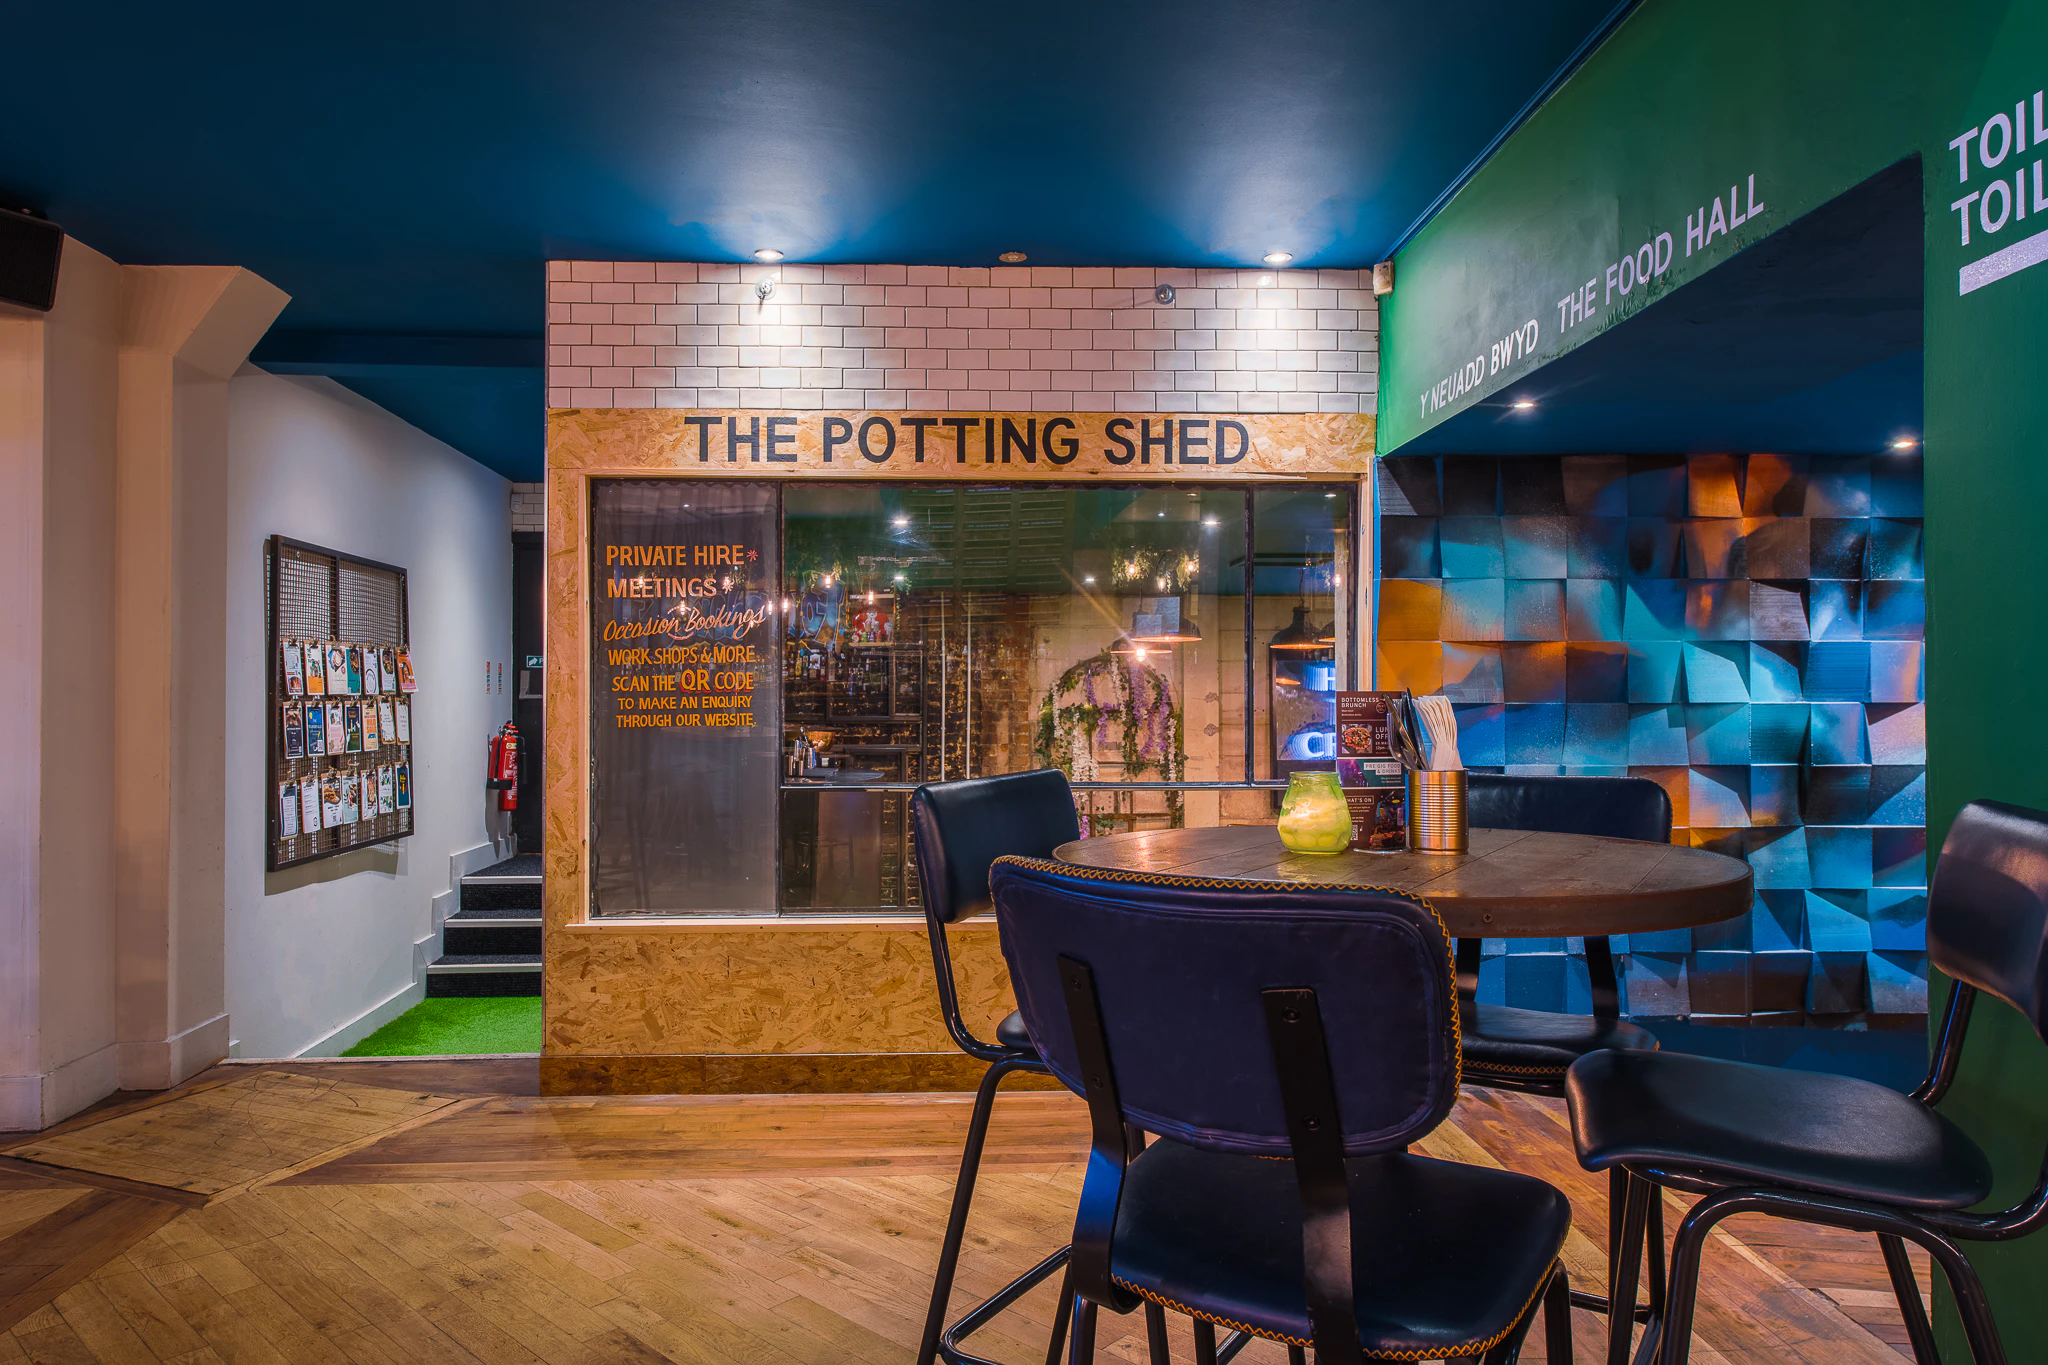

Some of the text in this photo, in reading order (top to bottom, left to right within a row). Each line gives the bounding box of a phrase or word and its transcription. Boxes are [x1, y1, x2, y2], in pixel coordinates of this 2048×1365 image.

[1420, 173, 1765, 419] Y NEUADD BWYD THE FOOD HALL
[684, 416, 1250, 466] THE POTTING SHED
[606, 544, 745, 567] PRIVATE HIRE
[607, 577, 718, 599] MEETINGS
[603, 604, 767, 642] Occasion Bookings
[700, 648, 712, 664] &
[611, 669, 755, 693] SCAN THE QR CODE
[617, 695, 753, 711] TO MAKE AN ENQUIRY
[616, 712, 757, 729] THROUGH OUR WEBSITE.
